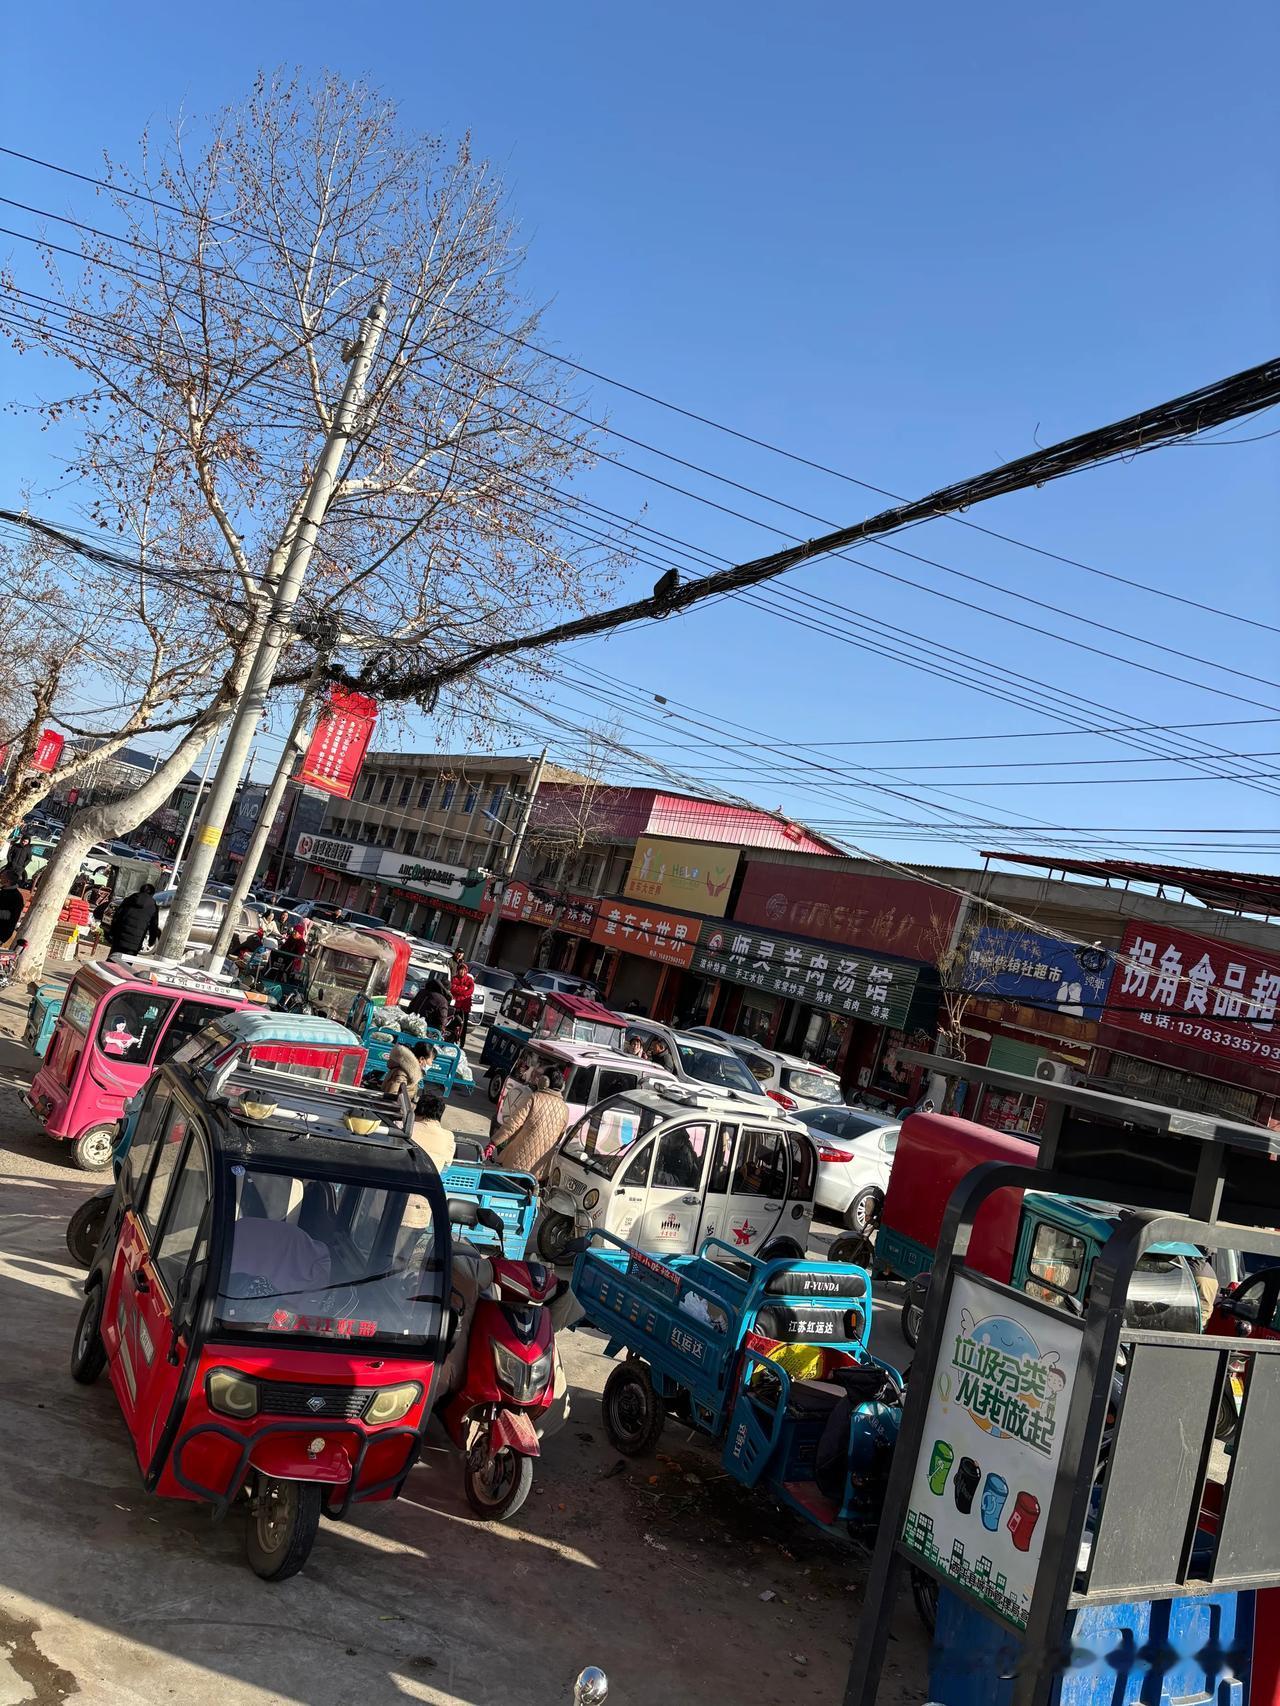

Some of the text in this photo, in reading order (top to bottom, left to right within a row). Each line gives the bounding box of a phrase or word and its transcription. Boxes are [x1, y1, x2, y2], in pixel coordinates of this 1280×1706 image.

[604, 908, 688, 952] 童车大世界
[729, 934, 894, 1003] 师灵羊肉汤馆
[735, 968, 764, 985] 手工水饺
[774, 979, 806, 997] 家常炒菜
[816, 990, 834, 1005] 烧烤
[843, 998, 860, 1012] 卤肉
[870, 1004, 891, 1020] 凉菜
[803, 1280, 840, 1292] H-YUNDA
[670, 1327, 704, 1359] 红运达
[788, 1320, 834, 1334] 江苏红运达
[951, 1334, 1047, 1398] 垃圾分类
[955, 1371, 1056, 1455] 从我做起
